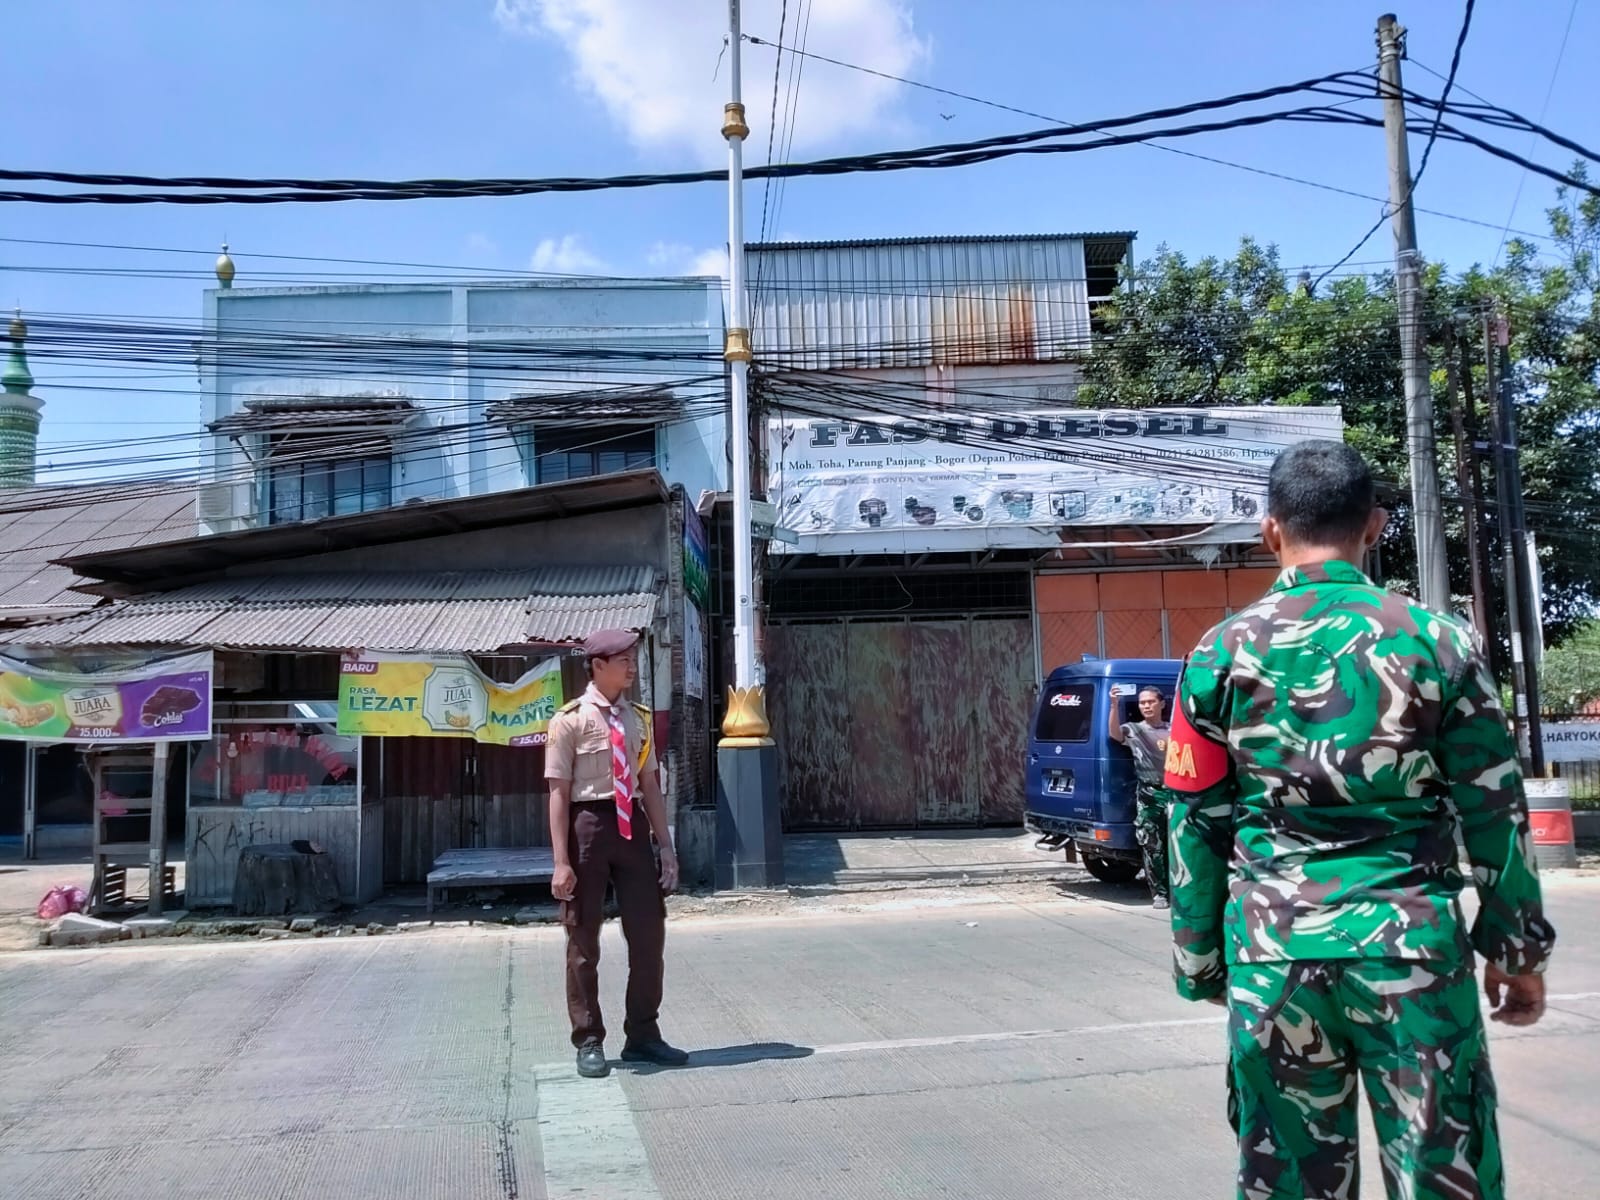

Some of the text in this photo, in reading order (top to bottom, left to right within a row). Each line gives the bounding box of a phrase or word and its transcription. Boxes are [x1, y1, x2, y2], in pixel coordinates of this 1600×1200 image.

[810, 420, 966, 447] FAST
[985, 411, 1228, 439] DIESEL
[789, 460, 815, 470] Moh.
[819, 458, 845, 469] Toha,
[848, 458, 883, 469] Parung
[886, 456, 926, 467] Panjang
[935, 455, 965, 466] Bogor
[968, 453, 1005, 465] (Depan
[342, 663, 375, 673] BARU
[350, 686, 376, 695] RASA
[74, 697, 111, 714] JUARA
[350, 696, 418, 712] LEZAT
[491, 704, 556, 727] MANIS
[79, 727, 112, 738] 15.000
